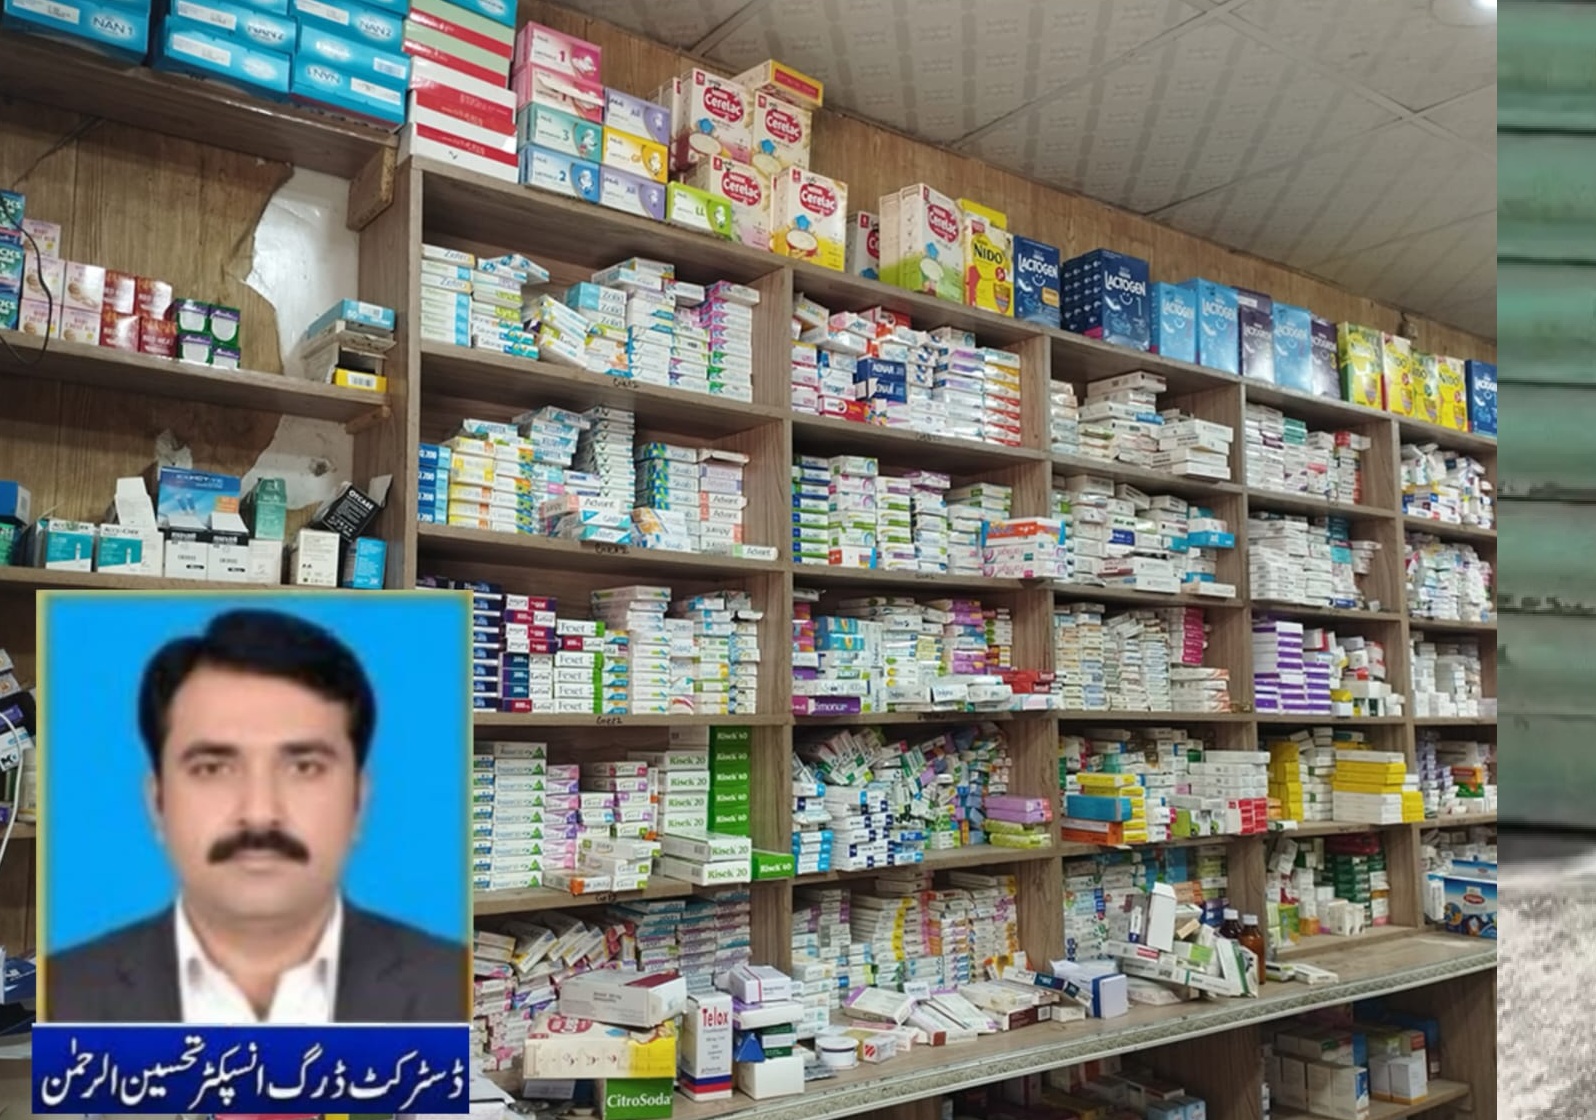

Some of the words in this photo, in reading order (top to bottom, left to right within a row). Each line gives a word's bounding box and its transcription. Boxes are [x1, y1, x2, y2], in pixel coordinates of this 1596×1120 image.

[93, 15, 126, 34] NAN
[359, 20, 384, 36] NAN
[704, 92, 742, 117] Cerelac
[766, 114, 801, 138] Cerelac
[723, 179, 762, 201] Cerelac
[801, 189, 836, 212] Cerelac
[973, 243, 1003, 265] NIDO
[1017, 253, 1059, 279] LACTOGEN
[1104, 270, 1146, 297] LACTOGEN
[1162, 299, 1195, 319] LACTOGEN
[1201, 298, 1237, 322] LACTOGEN
[559, 654, 584, 665] Fexet
[558, 671, 583, 681] Fexet
[559, 685, 583, 696] Fexet
[558, 701, 583, 712] Fexet
[670, 755, 693, 765] Risek
[694, 755, 706, 765] 20
[671, 777, 694, 787] Risek
[694, 776, 707, 786] 20
[668, 798, 691, 807] Risek
[693, 797, 705, 807] 20
[667, 817, 691, 827] Risek
[693, 817, 704, 827] 20
[712, 846, 736, 856] Risek
[737, 844, 749, 855] 20
[707, 868, 735, 880] Risek
[735, 867, 748, 877] 20
[760, 863, 781, 873] Risek
[702, 1006, 729, 1027] Telox
[607, 1093, 672, 1108] CitroSoda
